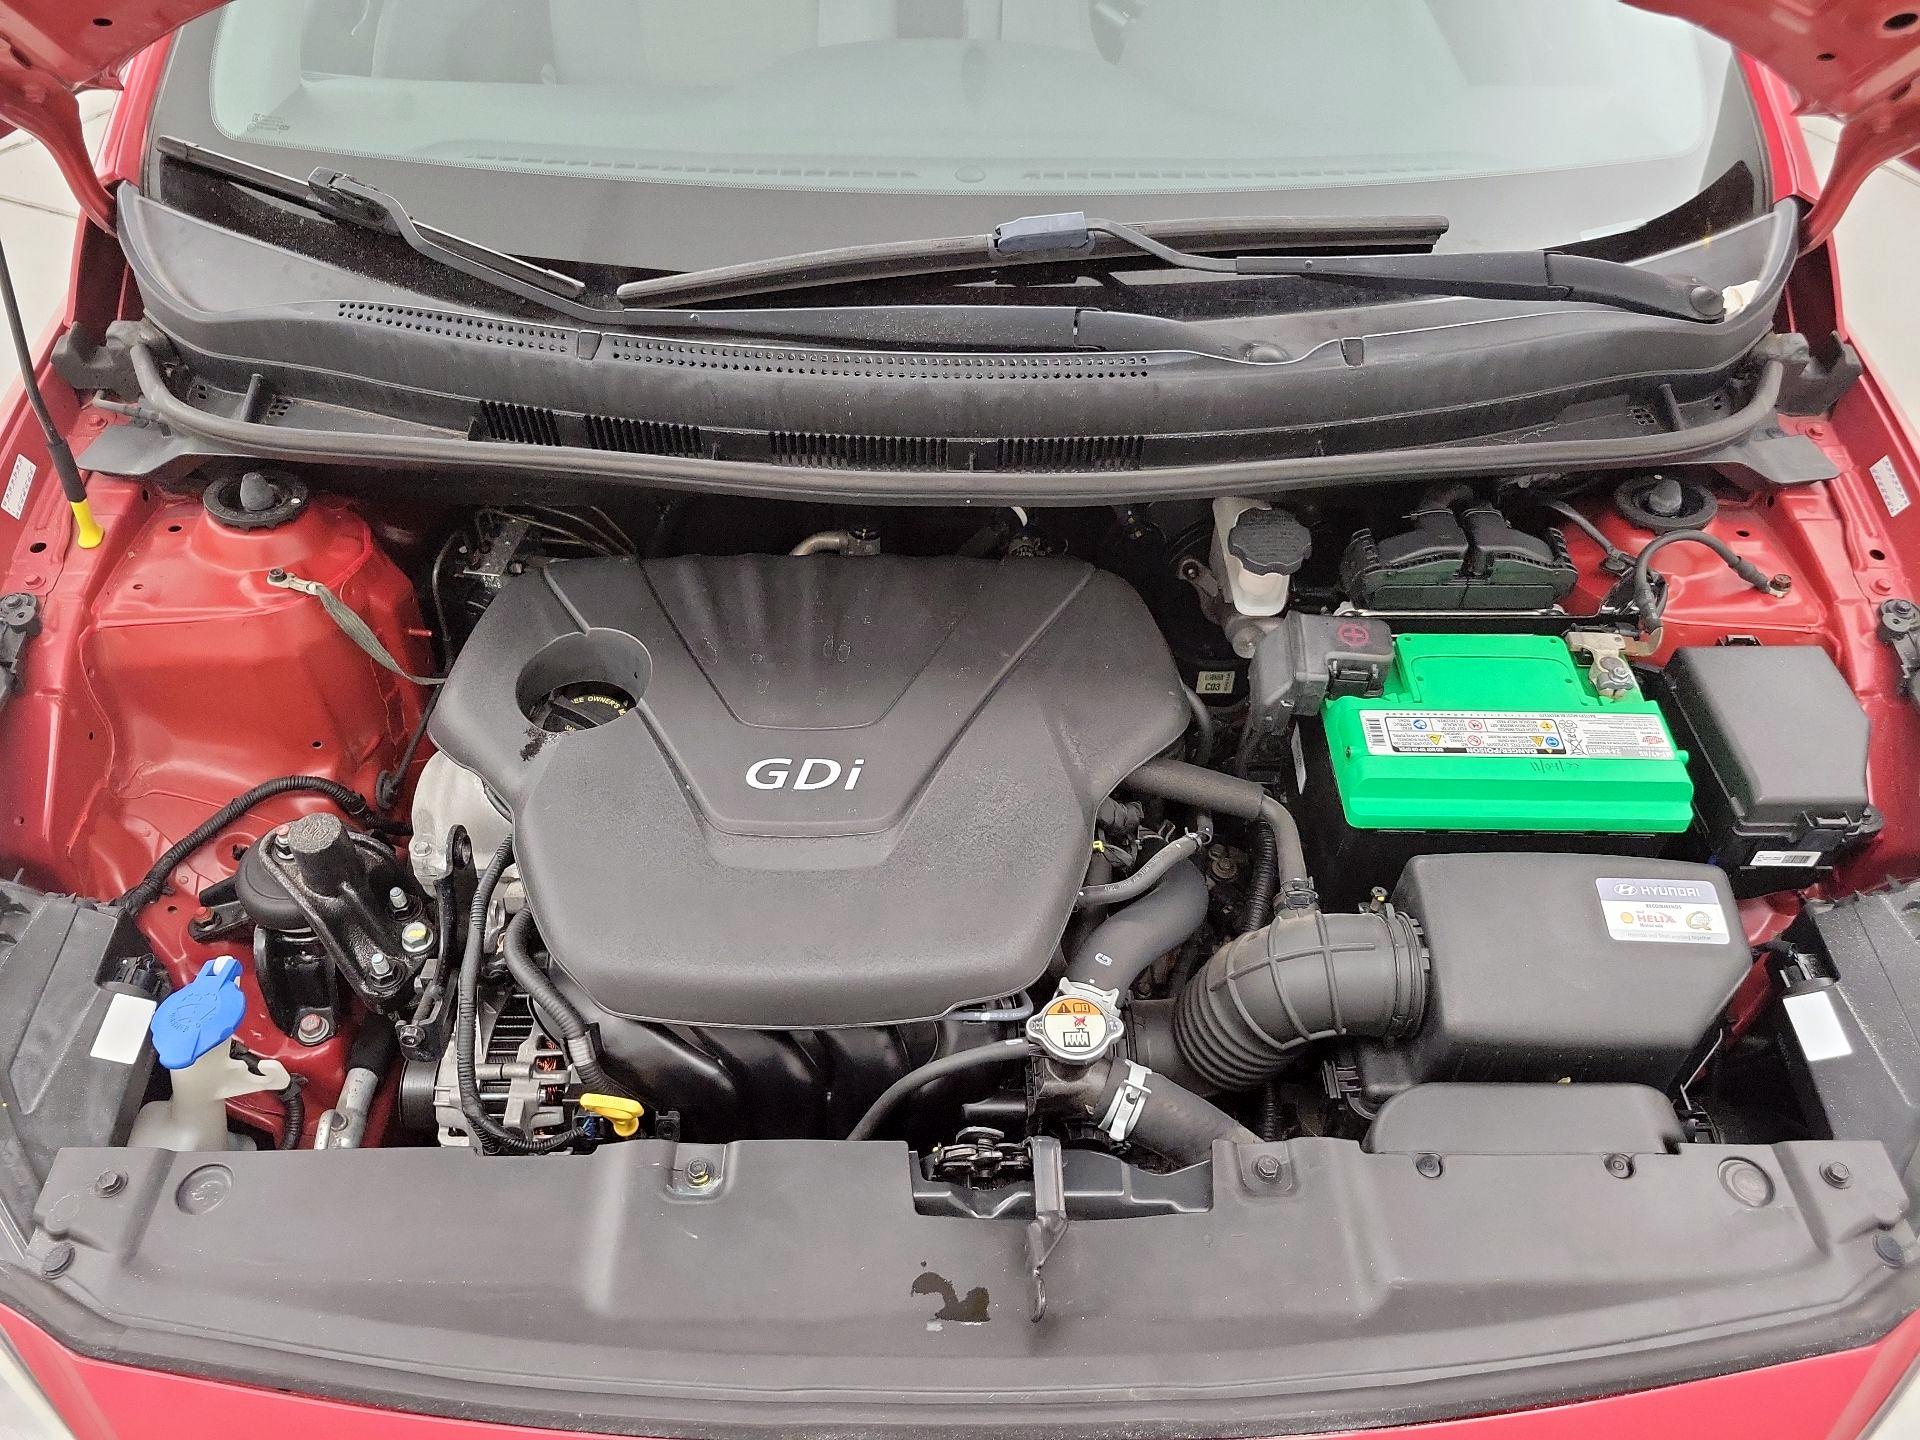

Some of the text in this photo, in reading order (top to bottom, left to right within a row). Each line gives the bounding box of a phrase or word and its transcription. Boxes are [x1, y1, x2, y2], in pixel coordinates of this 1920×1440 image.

[587, 695, 621, 709] OWNER'S
[746, 758, 864, 790] GDi
[1641, 886, 1701, 896] HYUNDAI
[1637, 912, 1676, 924] HELIX
